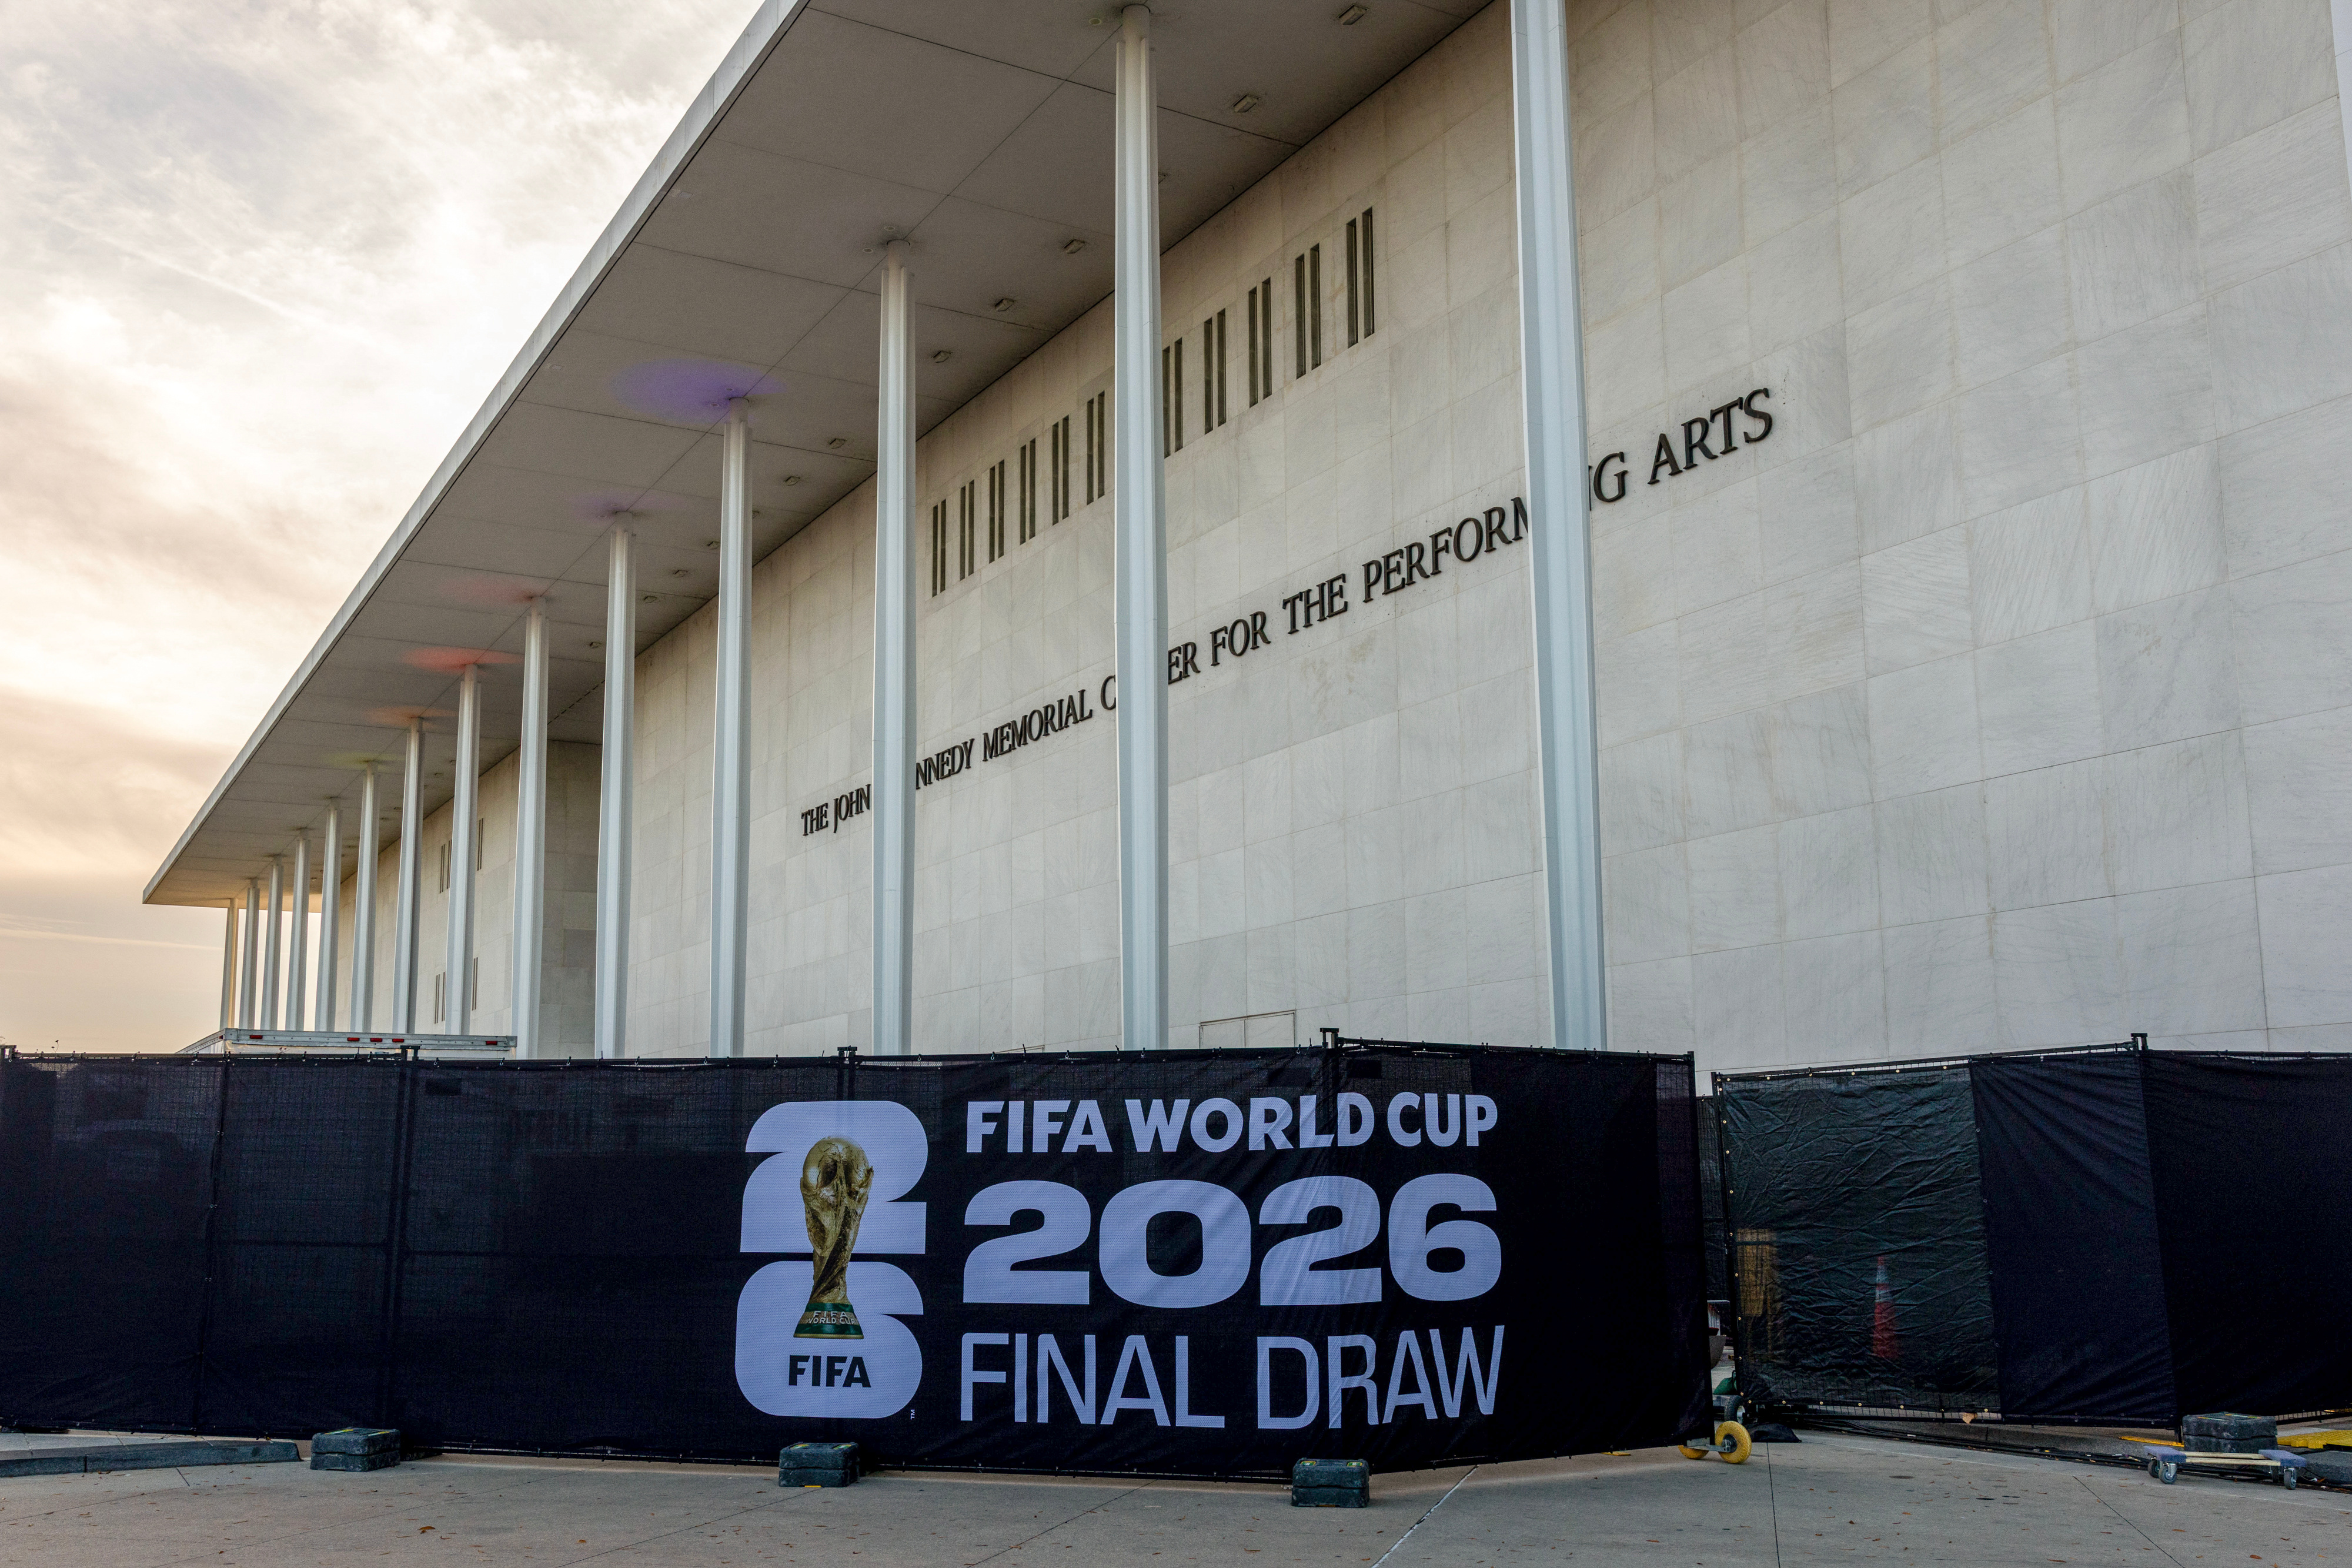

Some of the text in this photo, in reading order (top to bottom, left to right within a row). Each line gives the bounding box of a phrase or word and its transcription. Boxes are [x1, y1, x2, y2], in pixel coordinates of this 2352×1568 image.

[801, 803, 828, 836] THE
[833, 784, 871, 834] JOHN
[916, 738, 975, 790] NNEDY
[982, 689, 1093, 761] MEMORIAL
[1210, 611, 1271, 666] FOR
[1282, 573, 1348, 634] THE
[1647, 387, 1773, 485] ARTS
[966, 1092, 1498, 1153] FIFA WORLD CUP
[963, 1173, 1502, 1308] 2026
[788, 1355, 871, 1388] FIFA
[960, 1325, 1505, 1429] FINAL DRAW
